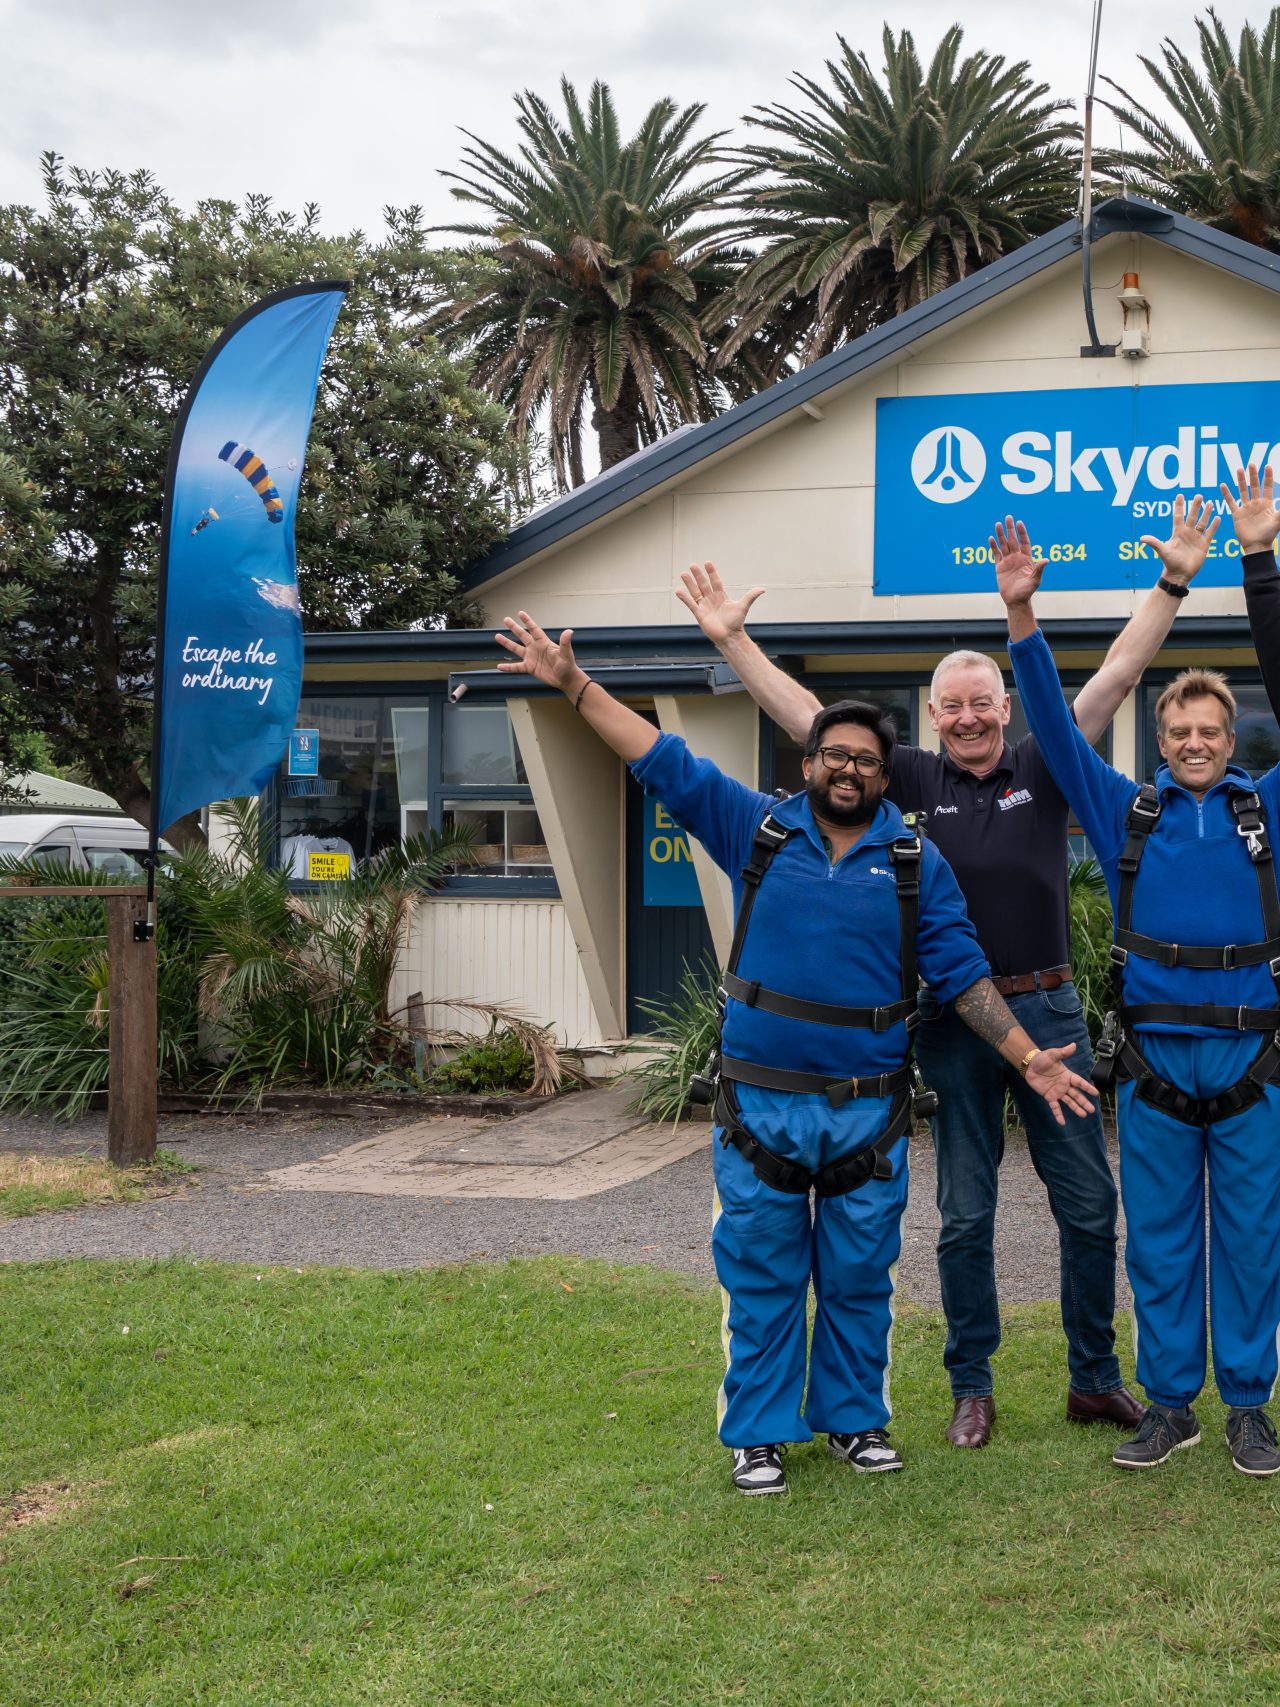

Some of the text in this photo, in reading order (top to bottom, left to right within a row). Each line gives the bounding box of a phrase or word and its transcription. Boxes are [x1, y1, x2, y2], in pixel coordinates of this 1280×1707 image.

[1049, 543, 1087, 562] 634
[182, 636, 278, 676] Escape the
[182, 662, 274, 706] ordinary
[311, 857, 335, 865] SMILE
